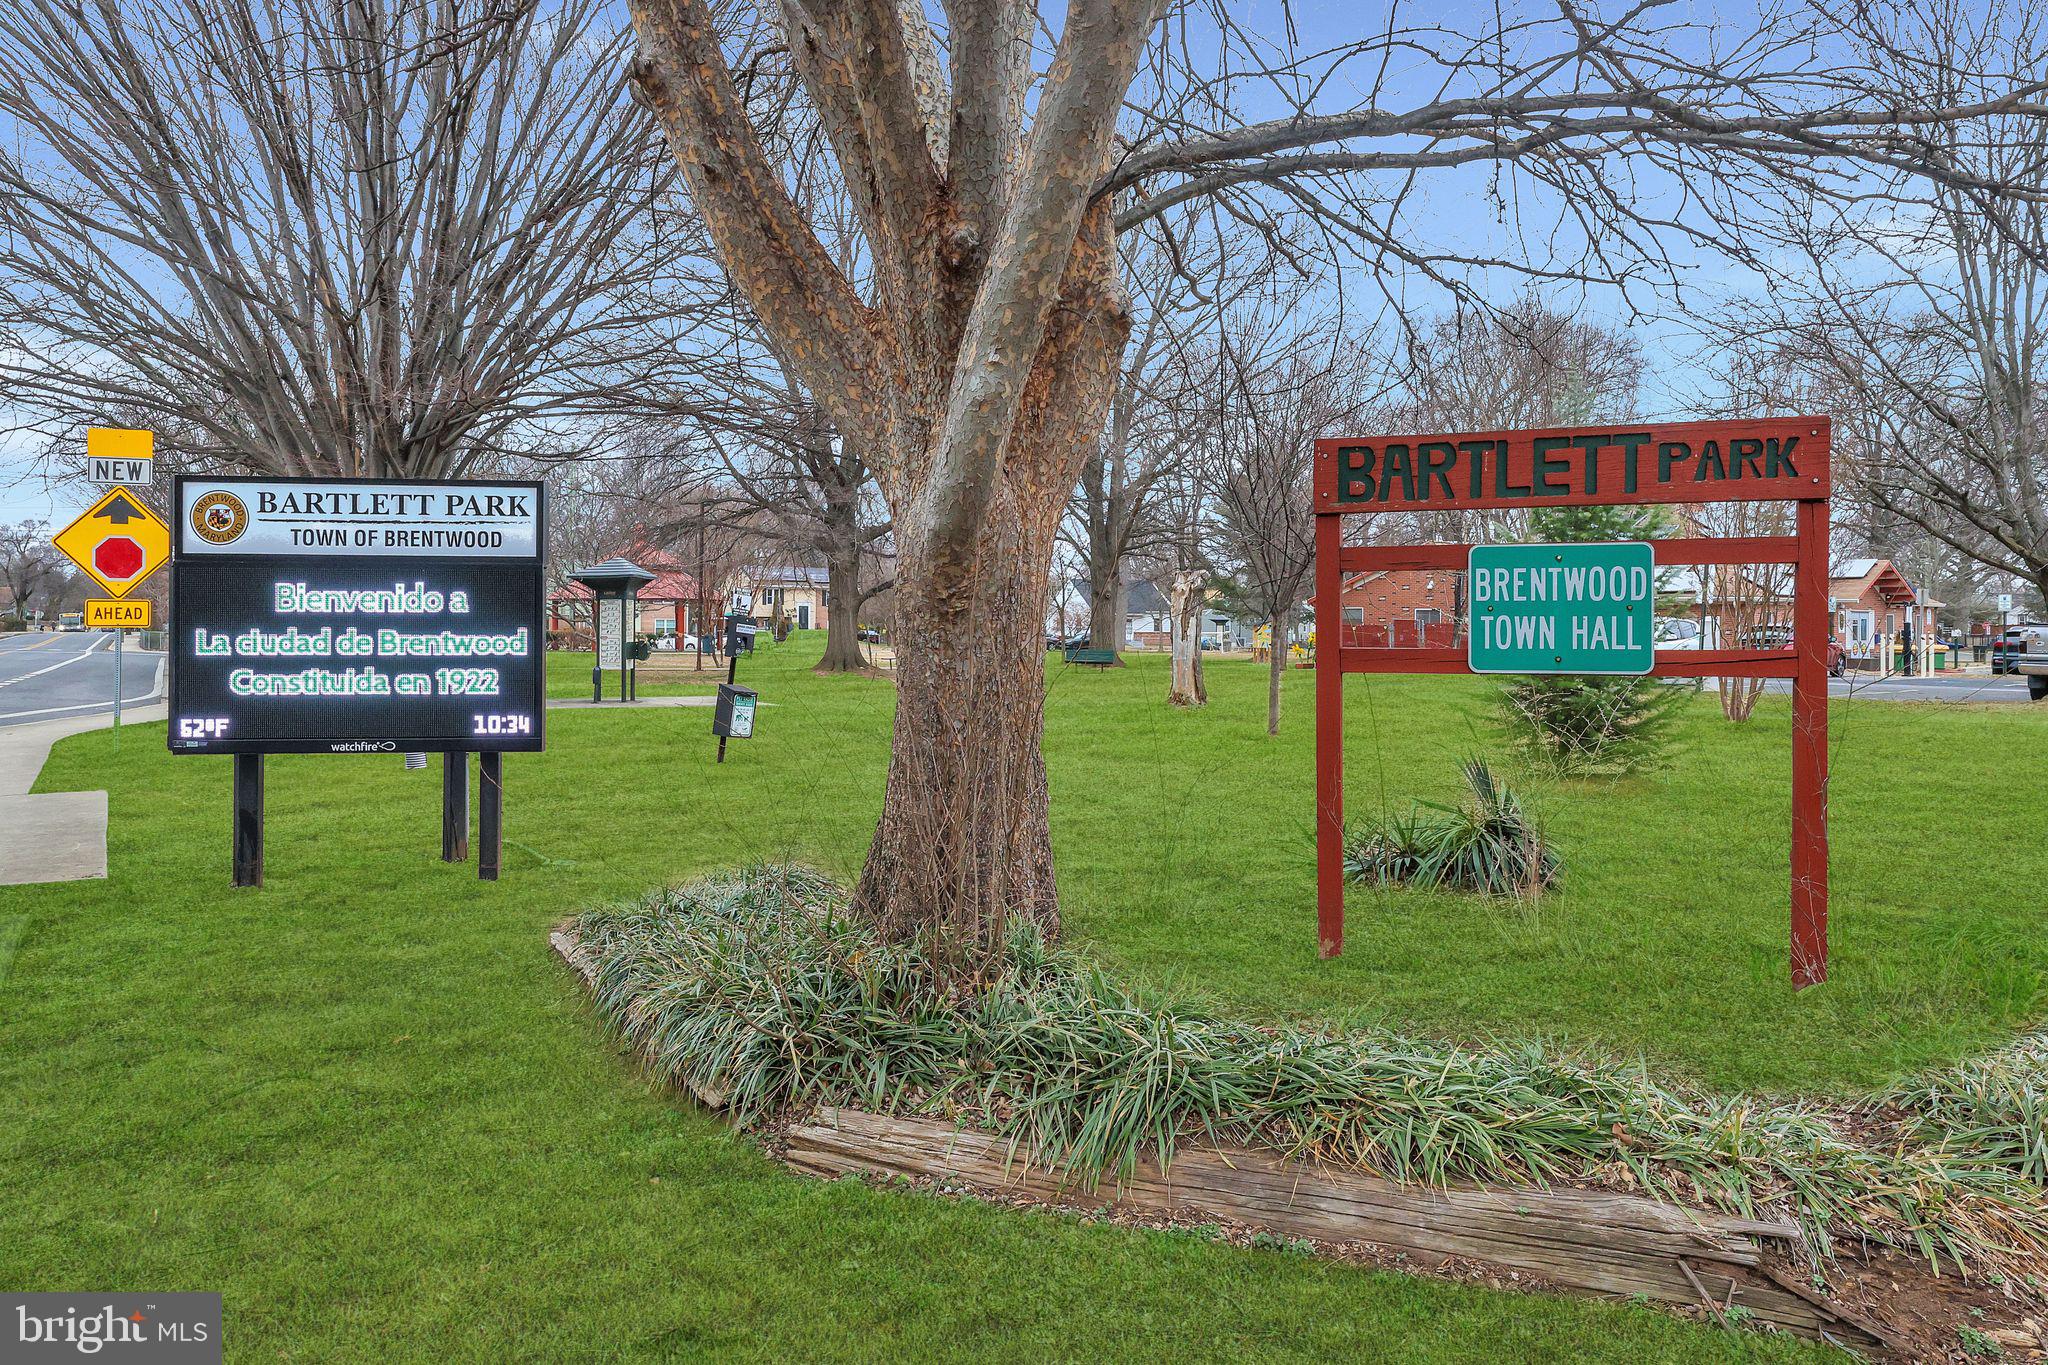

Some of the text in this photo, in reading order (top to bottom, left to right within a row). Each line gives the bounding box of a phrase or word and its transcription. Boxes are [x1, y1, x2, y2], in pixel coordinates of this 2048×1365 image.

[95, 461, 143, 481] NEW
[1337, 432, 1801, 503] BARTLETT PARK
[195, 494, 244, 517] BRENTWOOD
[257, 491, 530, 517] BARTLETT PARK
[196, 522, 244, 542] MARYLAND
[290, 528, 503, 548] TOWN OF BRENTWOOD
[1476, 565, 1648, 602] BRENTWOOD
[274, 581, 469, 613] Bienvenido a
[94, 607, 142, 620] AHEAD
[195, 626, 528, 655] La ciudad de Brentwood
[1480, 614, 1642, 651] TOWN HALL
[229, 666, 500, 695] Constituida en 1922
[474, 715, 530, 734] 10:34
[331, 741, 377, 752] watchfire
